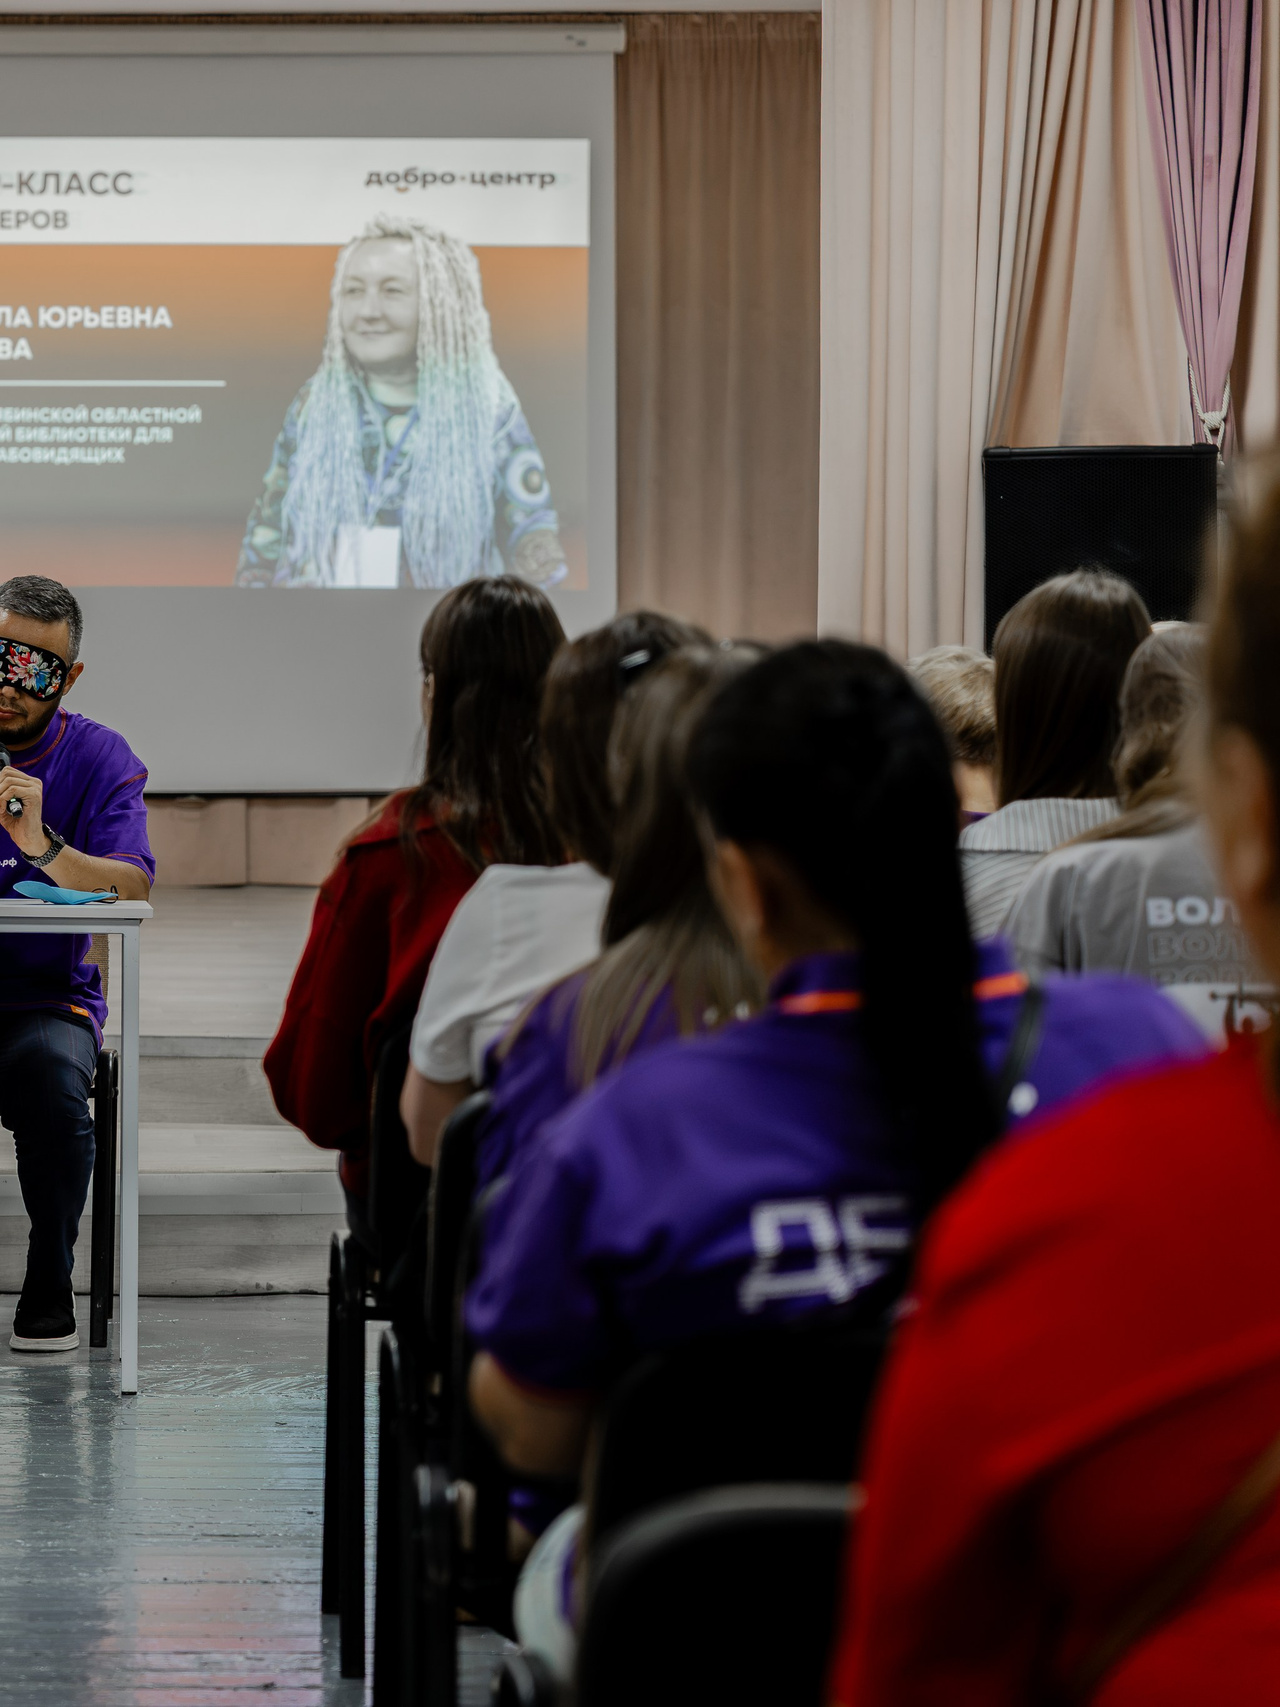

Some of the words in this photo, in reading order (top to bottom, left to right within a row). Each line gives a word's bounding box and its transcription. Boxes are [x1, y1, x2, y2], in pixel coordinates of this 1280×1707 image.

[38, 305, 173, 329] ЮРЬЕВНА
[90, 404, 202, 423] ОБЛАСТНОЙ
[15, 427, 132, 443] БИБЛИОТЕКИ
[134, 427, 173, 445] ДЛЯ
